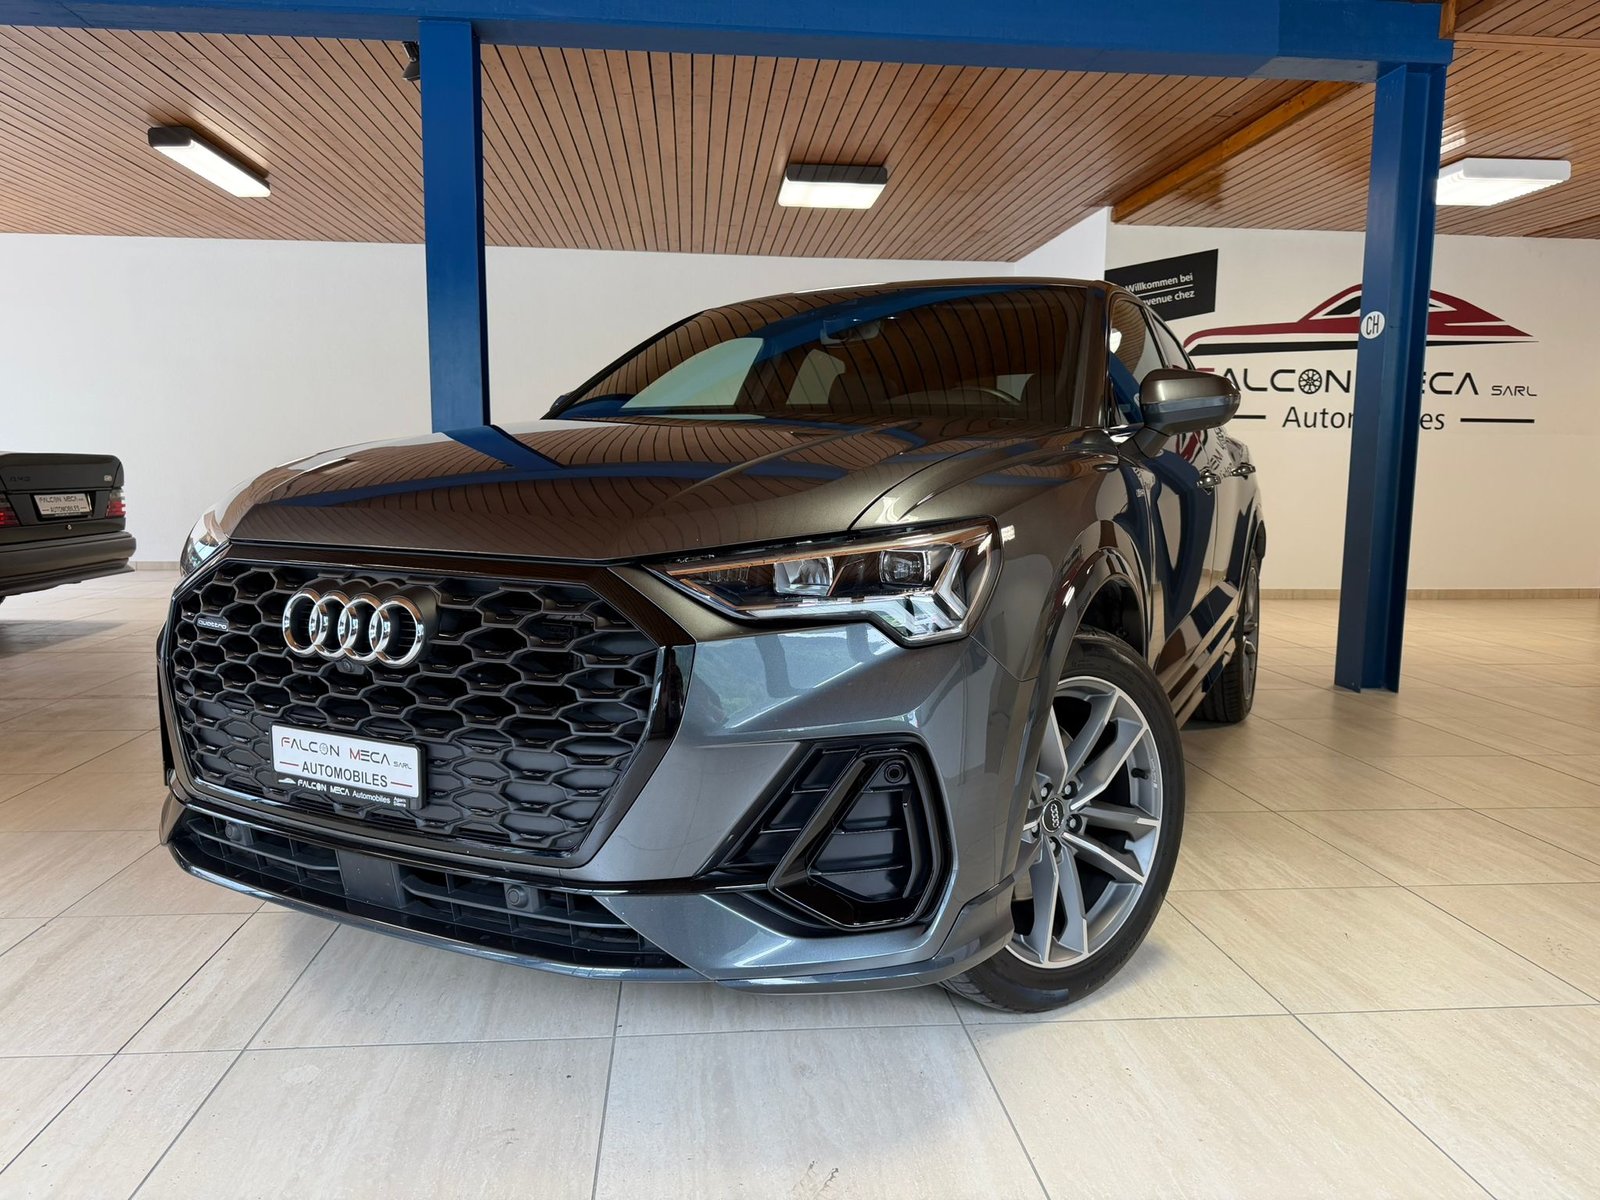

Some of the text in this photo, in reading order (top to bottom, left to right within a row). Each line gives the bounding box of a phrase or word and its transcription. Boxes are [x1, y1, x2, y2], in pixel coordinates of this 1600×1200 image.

[1124, 272, 1194, 293] Willkommen bei
[1143, 290, 1195, 306] venue chez
[1366, 314, 1380, 335] CH
[1491, 385, 1538, 397] SARL
[197, 619, 227, 630] quattro
[281, 736, 412, 770] FALCON MECA SARL
[301, 761, 388, 788] AUTOMOBILES
[297, 779, 391, 804] FALCON MECA Automobiles
